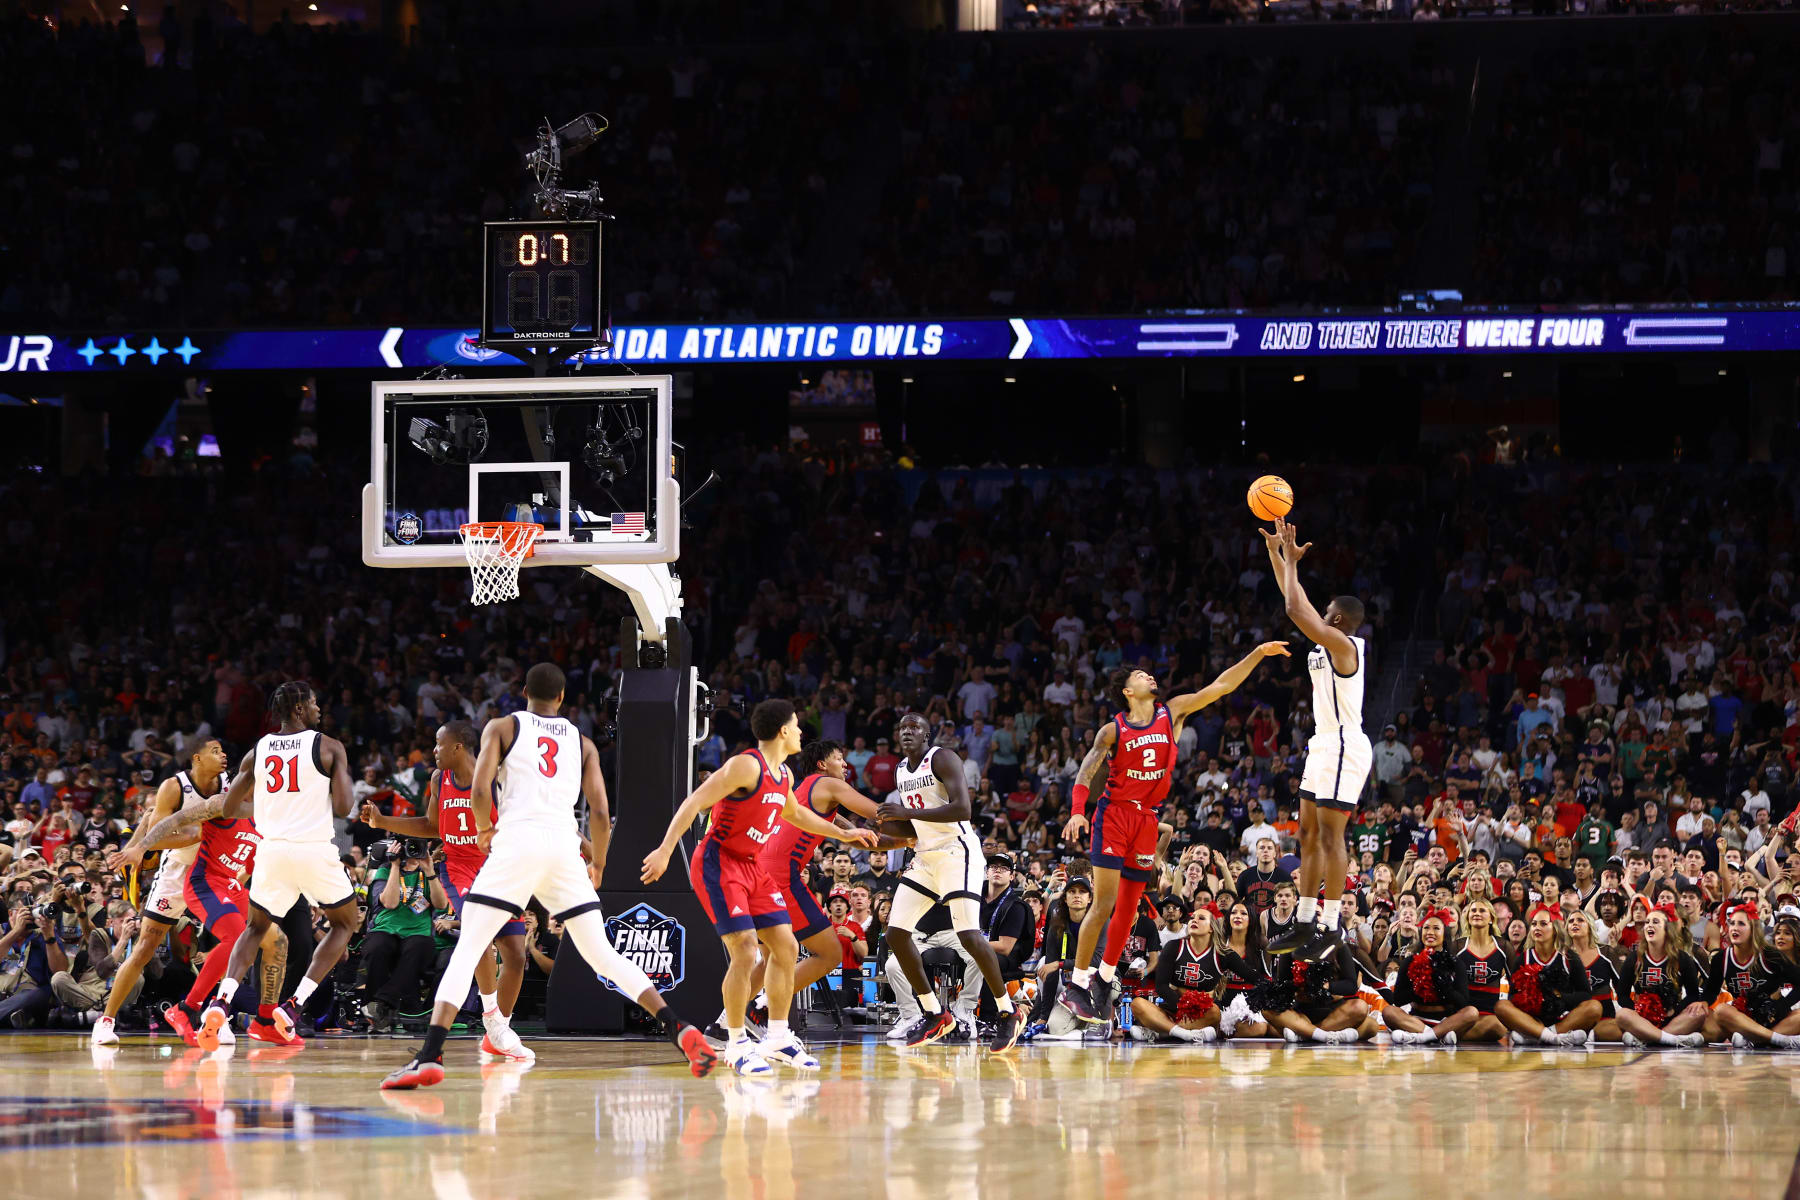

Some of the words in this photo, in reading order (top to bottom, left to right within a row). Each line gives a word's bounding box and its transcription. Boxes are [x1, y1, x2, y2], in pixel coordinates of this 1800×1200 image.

[680, 326, 839, 359] ATLANTIC
[850, 324, 944, 356] OWLS
[1260, 322, 1312, 350] AND
[1317, 321, 1380, 349] THEN
[1385, 320, 1462, 348] THERE
[1466, 319, 1535, 347] WERE
[1538, 318, 1604, 346] FOUR
[400, 520, 418, 529] FINAL
[401, 528, 419, 536] FOUR
[268, 739, 302, 751] MENSAH
[1125, 734, 1169, 752] FLORIDA
[537, 736, 559, 778] 3
[1142, 748, 1156, 767] 2
[265, 754, 300, 793] 31
[916, 774, 935, 789] STATE
[443, 798, 473, 810] FLORI
[457, 812, 469, 831] 1
[445, 833, 478, 845] ATLANT
[1359, 834, 1380, 853] 26
[1588, 827, 1600, 845] 3
[232, 843, 254, 861] 15
[614, 929, 670, 951] FINAL
